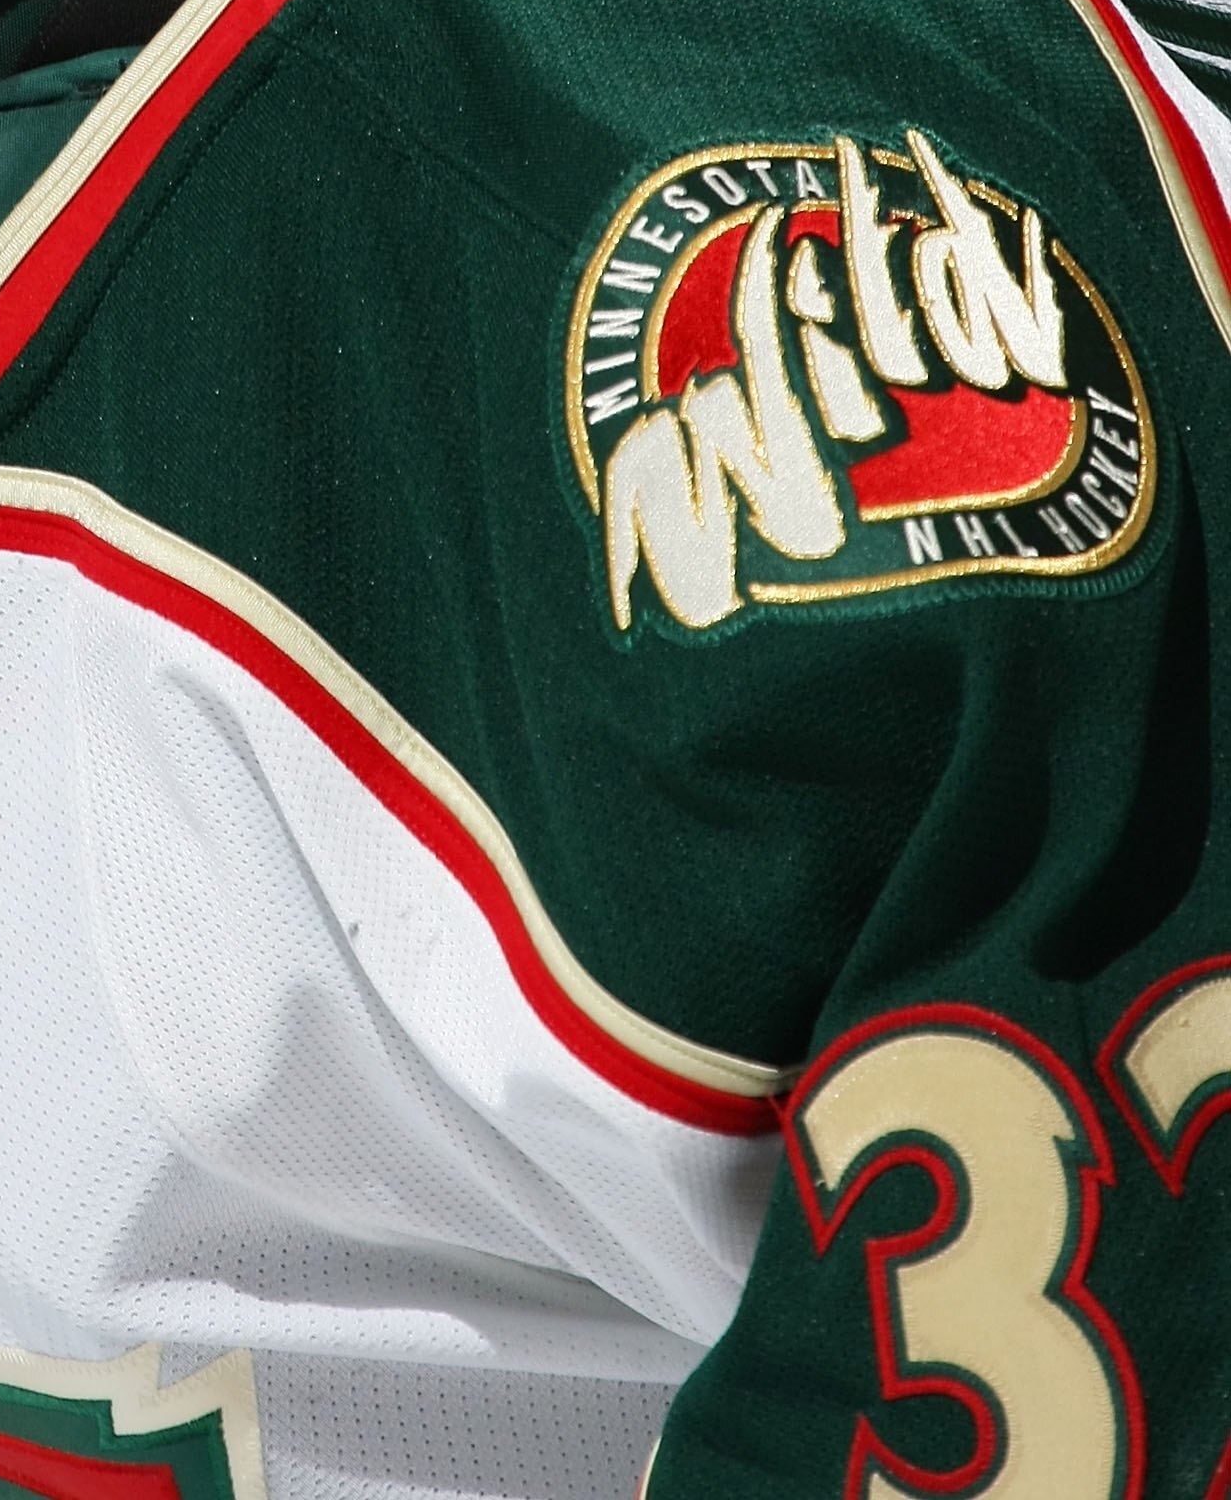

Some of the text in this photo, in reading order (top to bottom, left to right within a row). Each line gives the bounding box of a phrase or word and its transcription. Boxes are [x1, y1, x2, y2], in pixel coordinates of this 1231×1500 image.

[590, 159, 827, 427] MINNESOTA
[904, 386, 1139, 566] NHL HOCKEY
